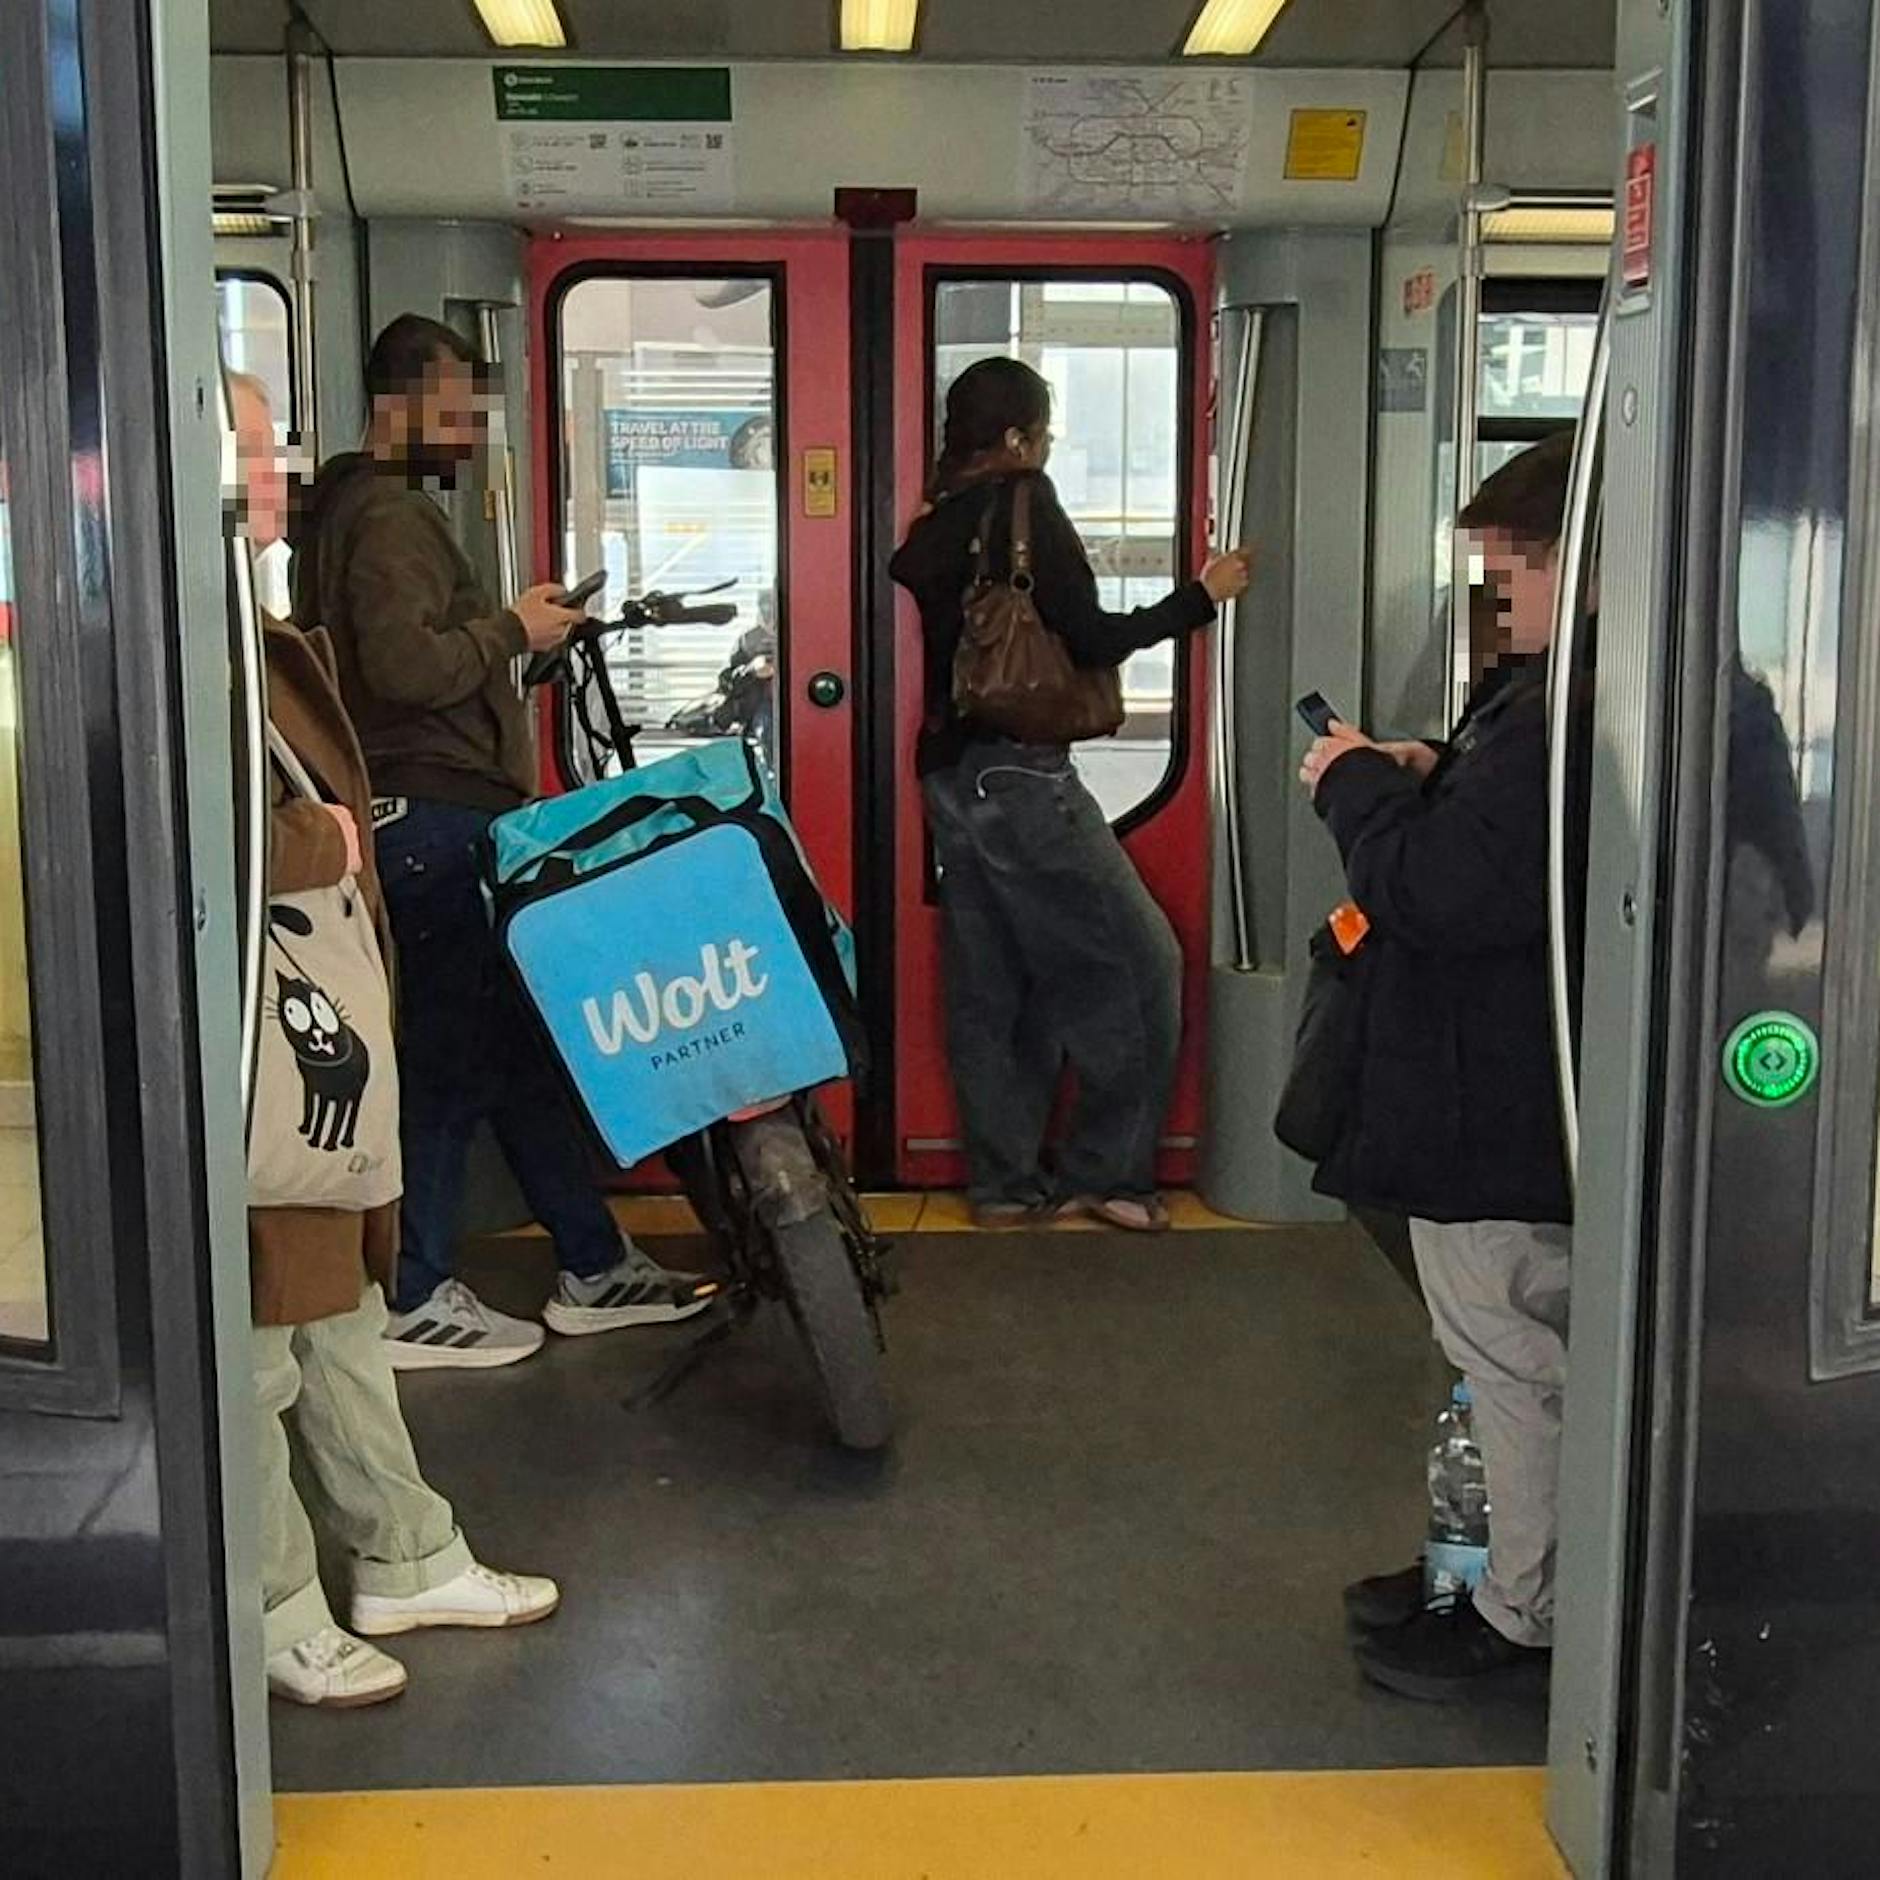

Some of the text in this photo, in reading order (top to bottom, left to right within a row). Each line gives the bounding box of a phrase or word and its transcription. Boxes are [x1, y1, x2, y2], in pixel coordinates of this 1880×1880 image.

[610, 421, 721, 435] TRAVEL AT THE
[610, 436, 729, 450] SPEED OF LIGHT
[582, 938, 769, 1056] Wolt
[650, 1021, 746, 1071] PARTNER
